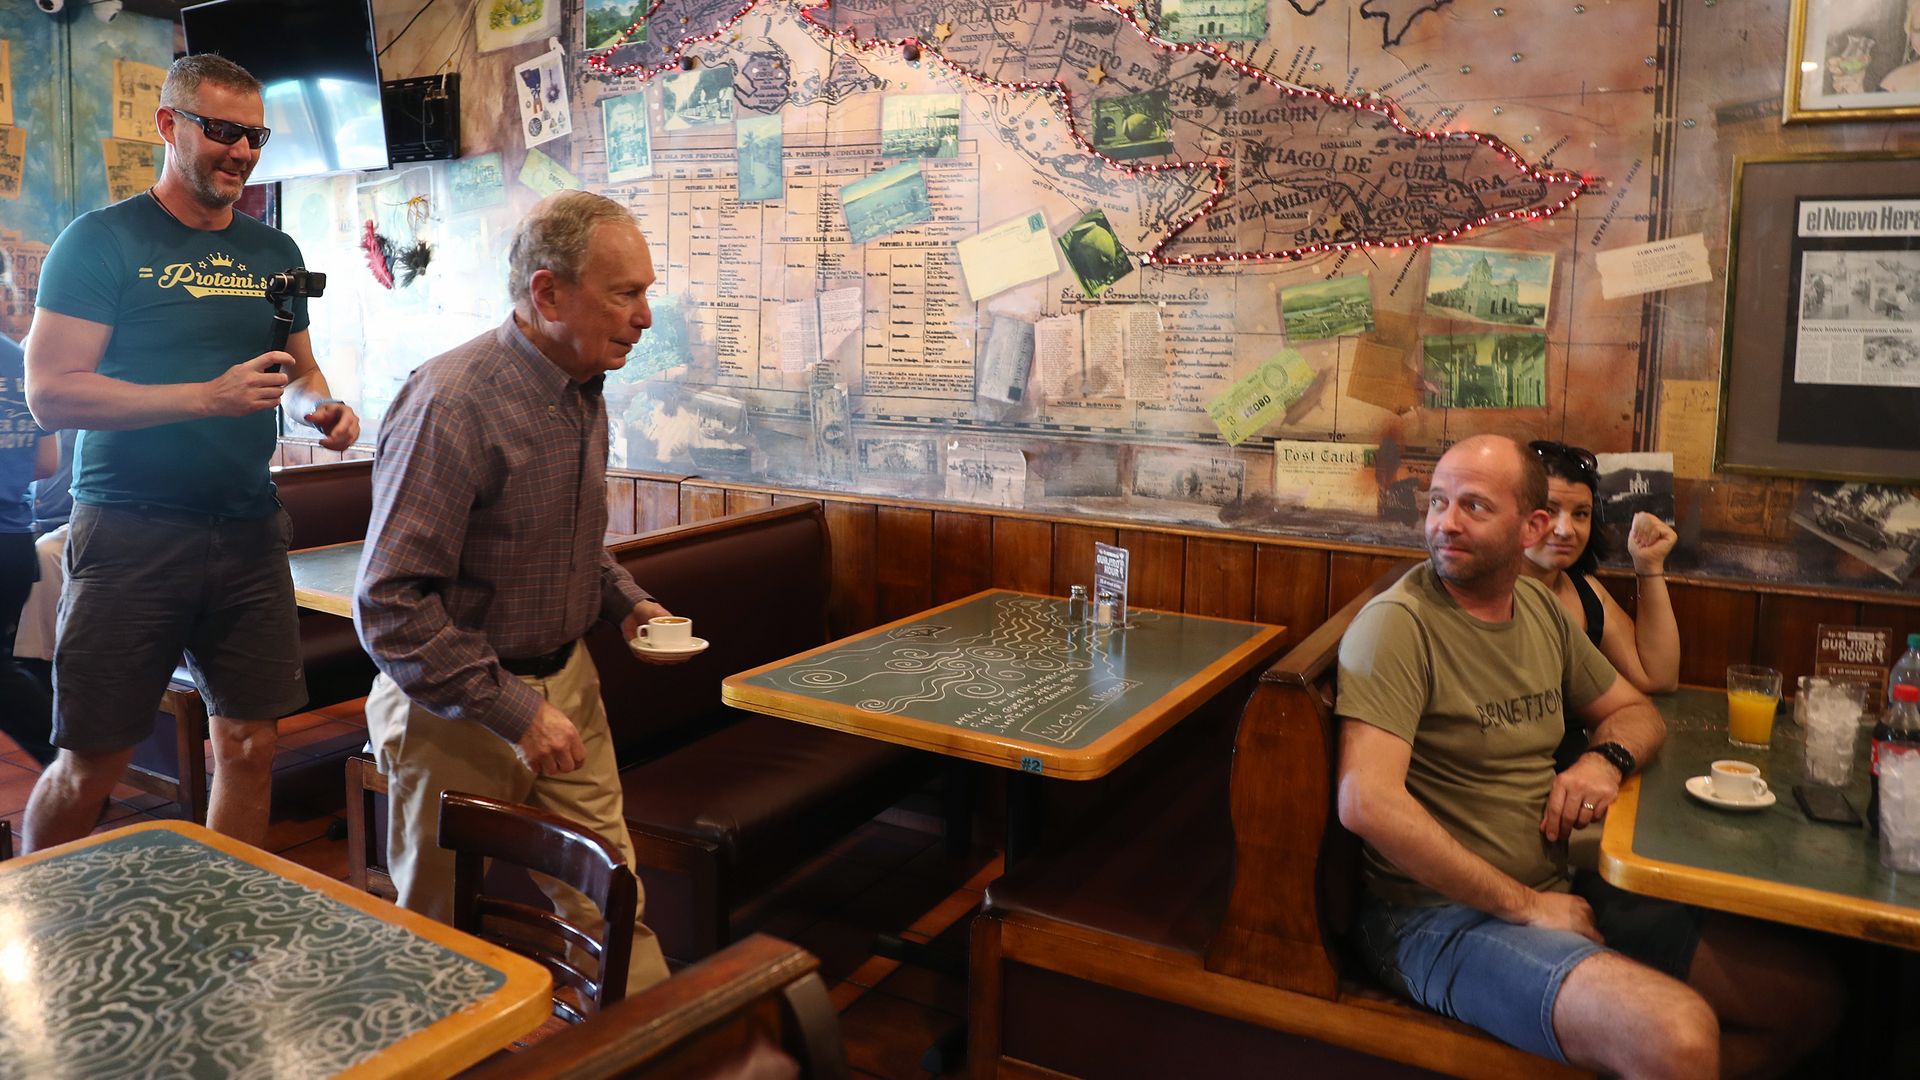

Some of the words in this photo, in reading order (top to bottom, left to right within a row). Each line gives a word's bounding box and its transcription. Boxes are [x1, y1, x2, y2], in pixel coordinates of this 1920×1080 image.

[1223, 106, 1318, 126] HOLGUIN
[1219, 140, 1327, 169] SNTIAGO
[1342, 154, 1373, 174] DE
[1205, 184, 1333, 232] MAZANILLO
[1806, 207, 1822, 231] el
[1823, 206, 1878, 231] Nuevo
[1182, 236, 1236, 244] MANZANILL
[1838, 648, 1874, 663] HOUR
[1021, 758, 1041, 772] #2
